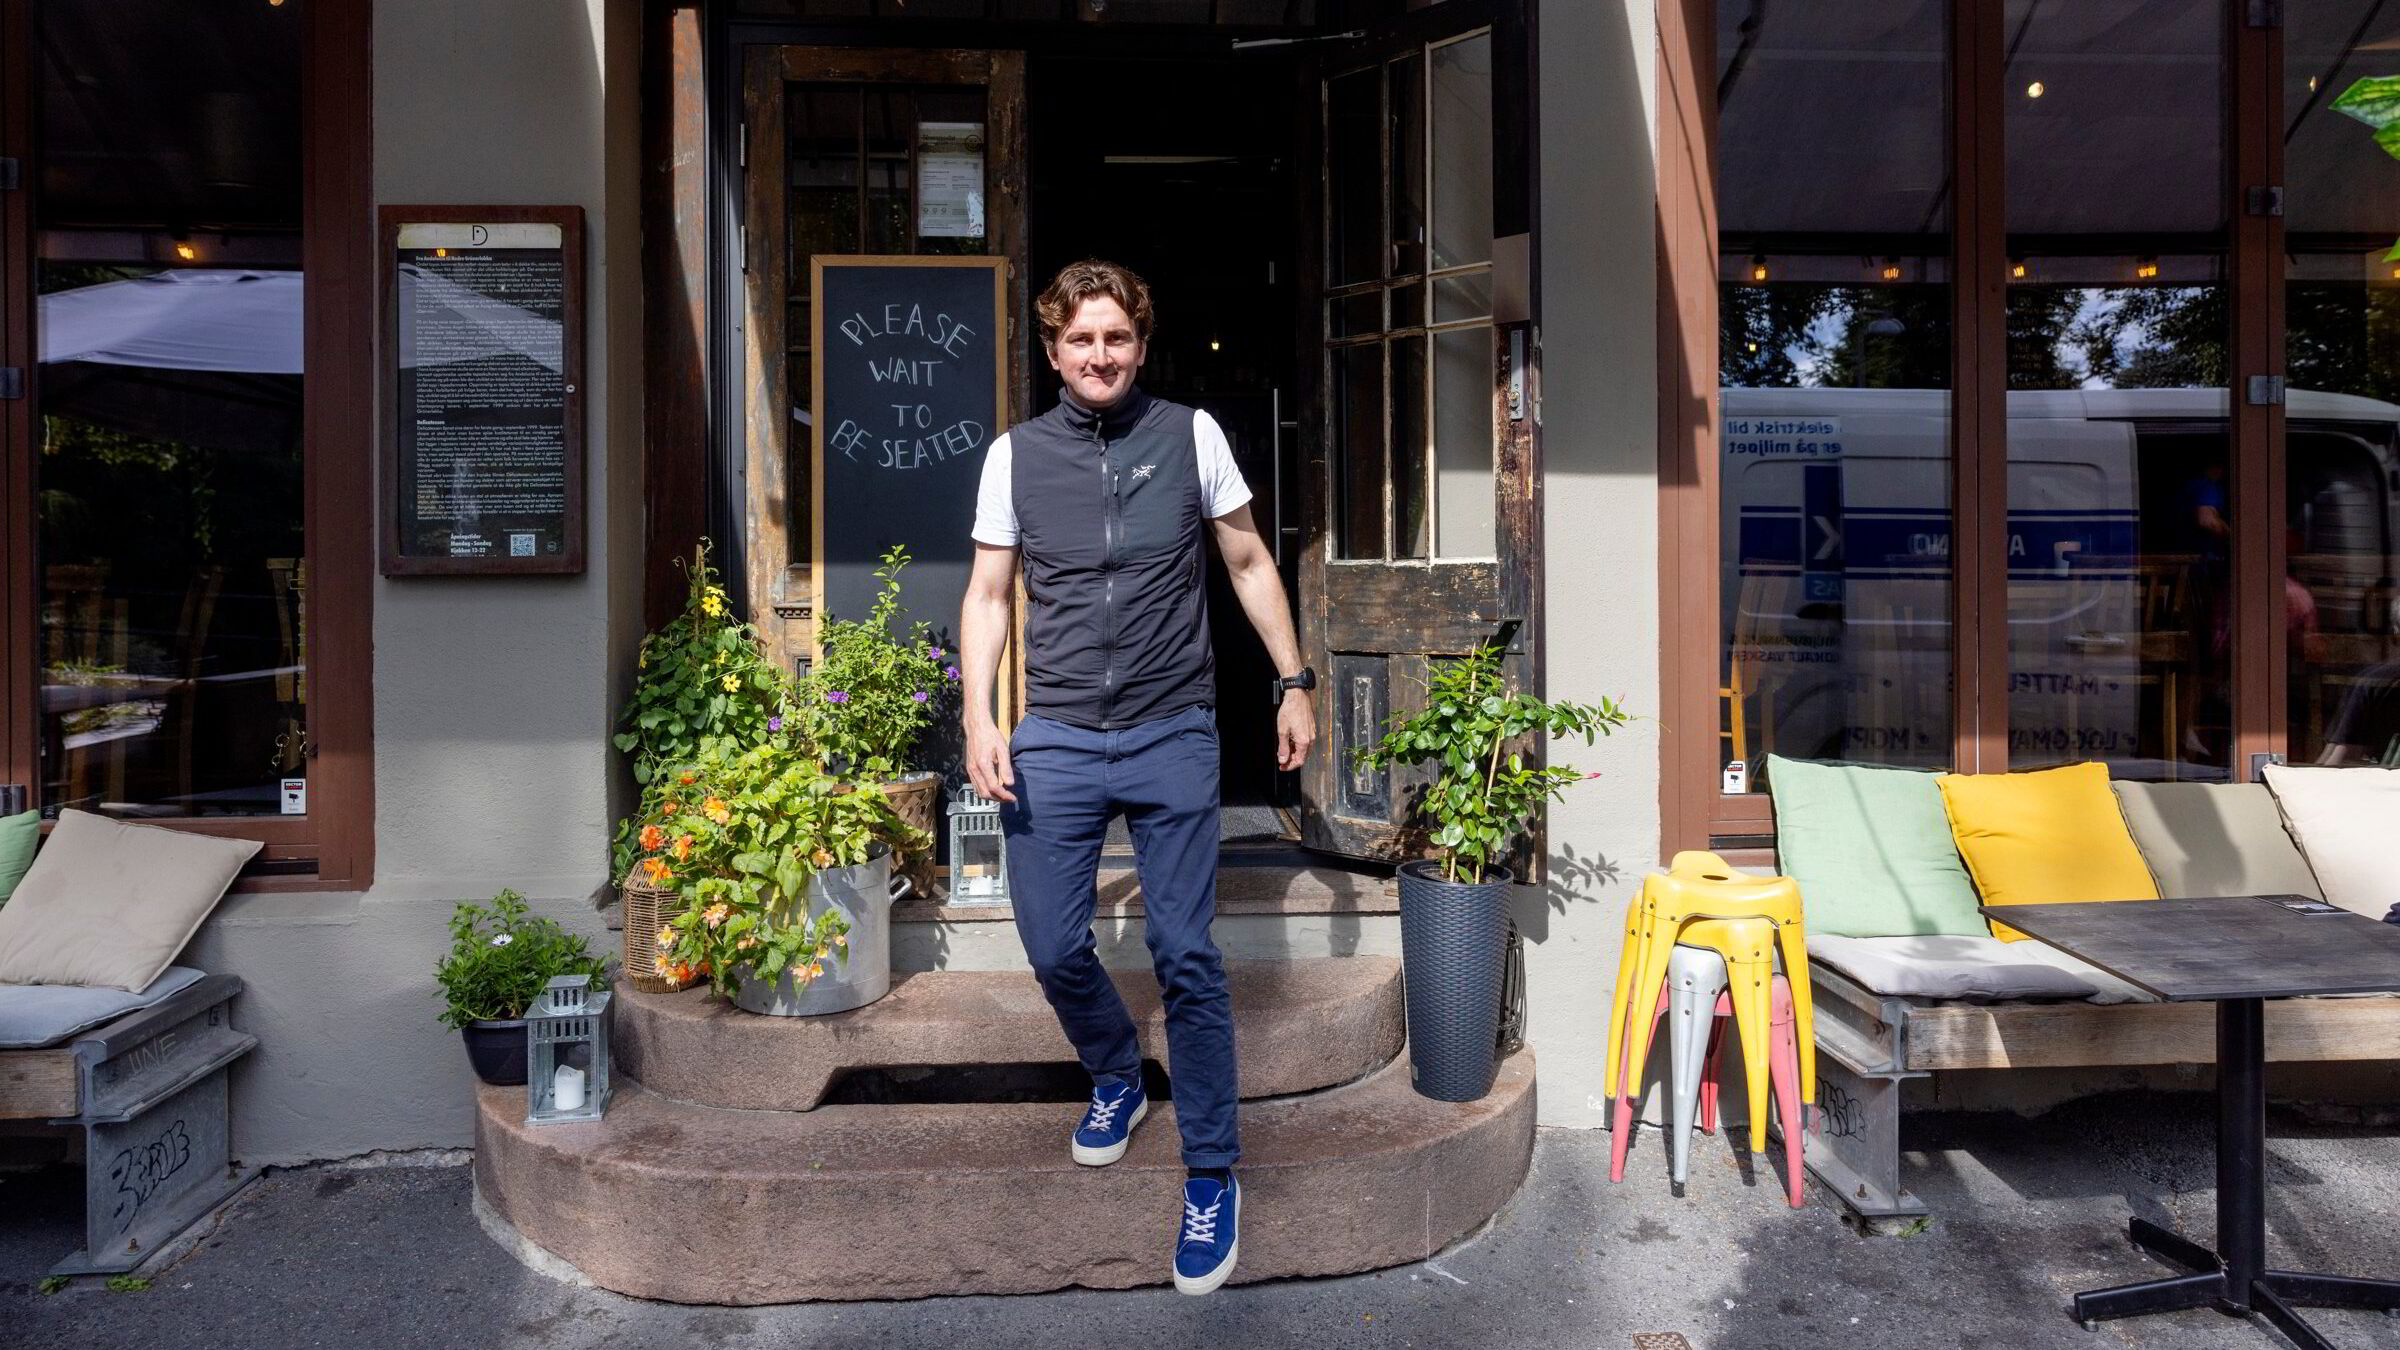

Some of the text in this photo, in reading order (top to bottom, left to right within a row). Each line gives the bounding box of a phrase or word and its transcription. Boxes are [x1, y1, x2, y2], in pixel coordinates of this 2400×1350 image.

[840, 303, 976, 358] PLEASE
[869, 356, 943, 387] WAIT
[891, 404, 932, 429] TO
[830, 419, 984, 469] BE SEATED
